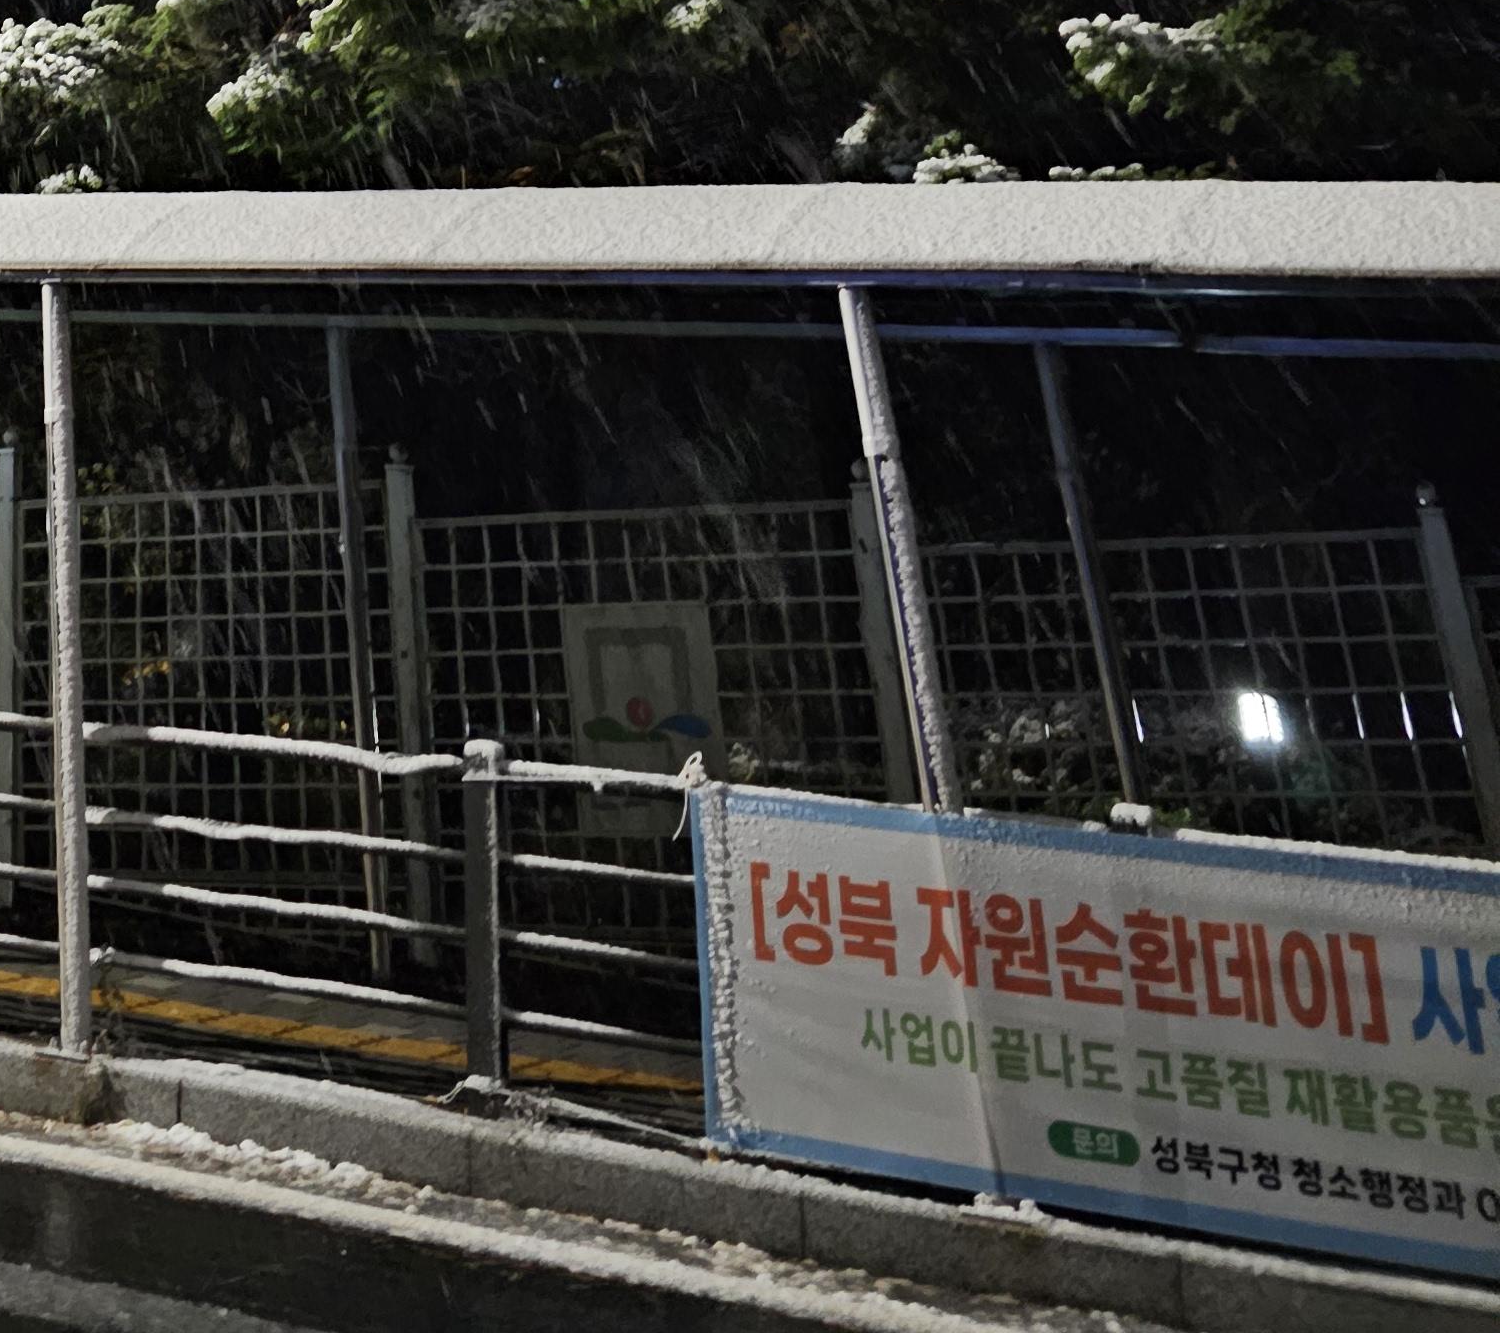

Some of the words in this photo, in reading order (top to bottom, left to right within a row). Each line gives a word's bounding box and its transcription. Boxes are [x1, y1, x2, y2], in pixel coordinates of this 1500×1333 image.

[750, 861, 898, 977] [성북
[917, 884, 1390, 1046] 자원순환데이]
[861, 1007, 978, 1074] 사업이
[990, 1025, 1124, 1093] 끝나도
[1136, 1048, 1271, 1119] 고품질
[1072, 1127, 1119, 1159] 문의
[1152, 1134, 1282, 1192] 성북구청
[1291, 1156, 1466, 1221] 청소행정과
